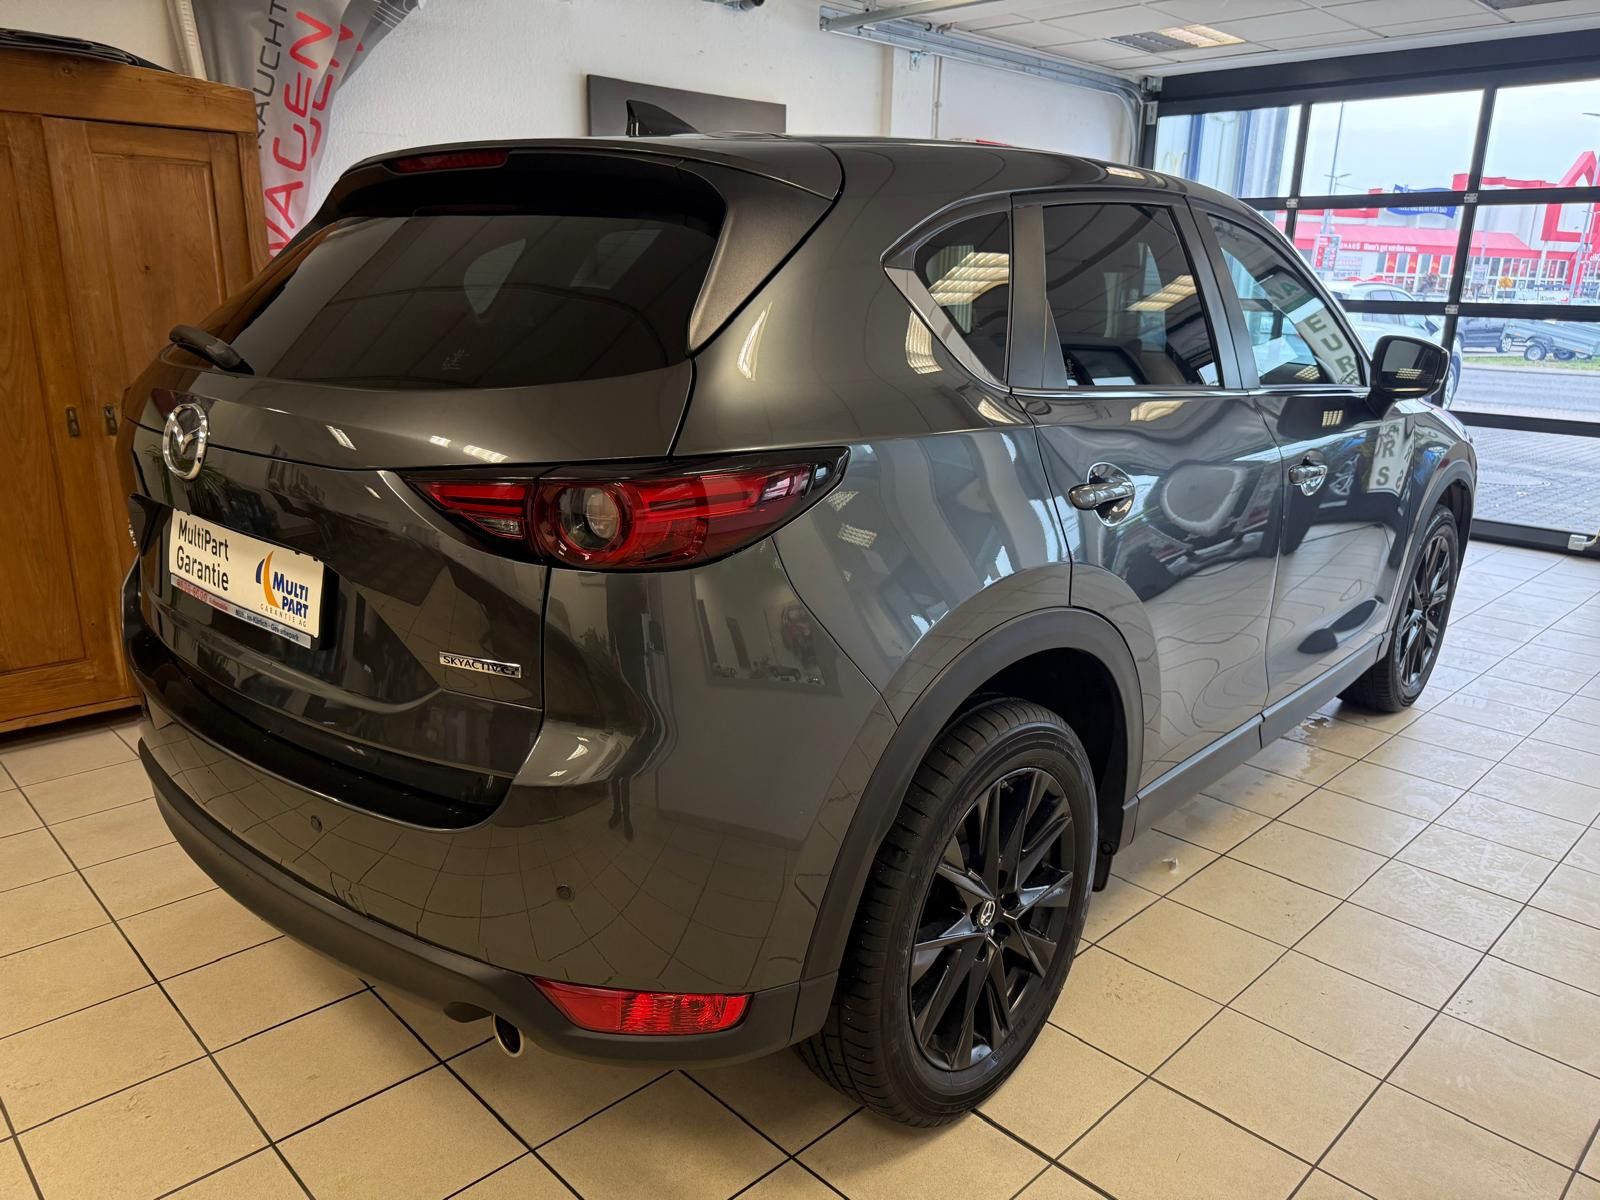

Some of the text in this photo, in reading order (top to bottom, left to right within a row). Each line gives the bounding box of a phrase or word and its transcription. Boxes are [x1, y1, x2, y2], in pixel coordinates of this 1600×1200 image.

[178, 518, 229, 561] MultiPart
[176, 545, 229, 592] Garantie
[272, 571, 309, 602] MULTI
[260, 603, 307, 628] GARANTIE AG
[281, 595, 309, 619] PART
